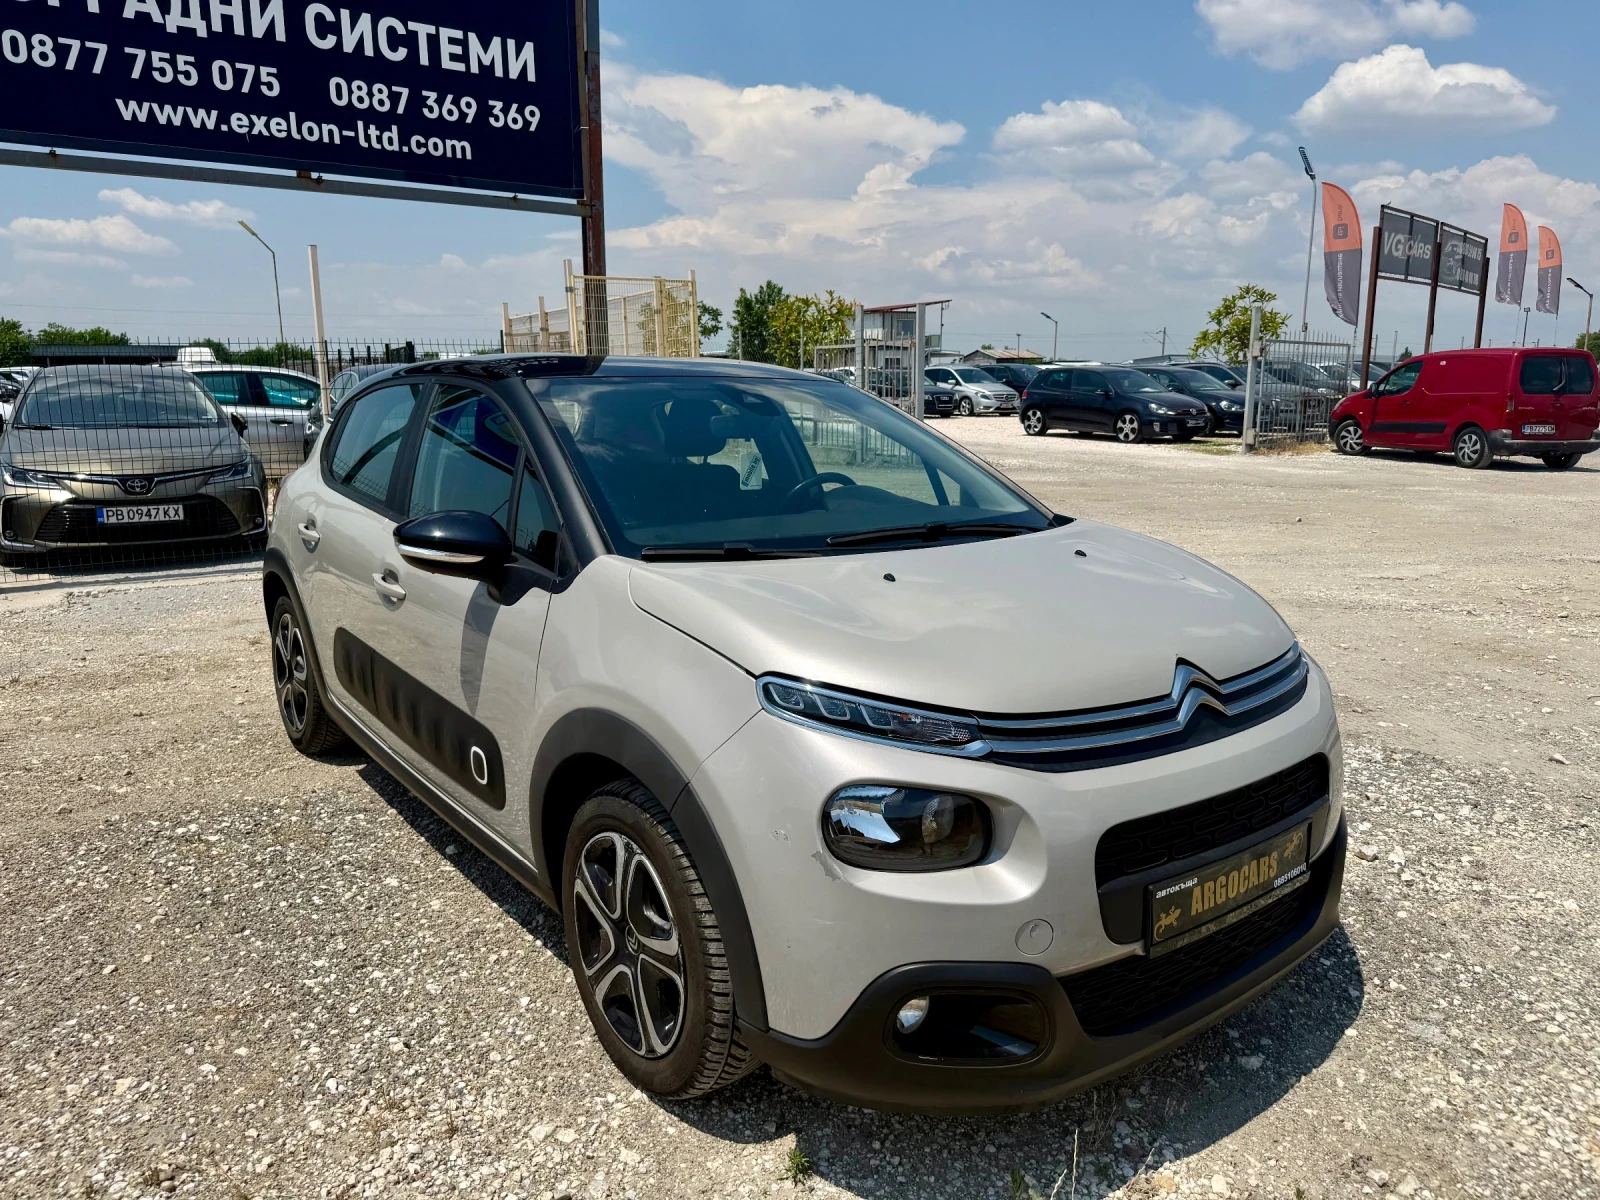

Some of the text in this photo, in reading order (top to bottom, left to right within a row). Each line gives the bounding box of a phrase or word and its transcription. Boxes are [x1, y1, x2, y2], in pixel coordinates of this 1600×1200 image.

[1, 29, 281, 97] 0877 755 075
[15, 0, 537, 83] АДНИ СИСТЕМИ
[115, 98, 473, 161] www.exelon-ltd.com
[328, 76, 541, 132] 0887 369 369
[1384, 231, 1405, 258] VG
[1405, 240, 1432, 259] CARS
[105, 509, 125, 522] PB
[127, 507, 160, 521] 0947
[163, 506, 181, 519] KX
[1155, 877, 1198, 899] автокъща
[1190, 851, 1278, 916] ARGOCARS
[1273, 862, 1307, 888] 0885106010
